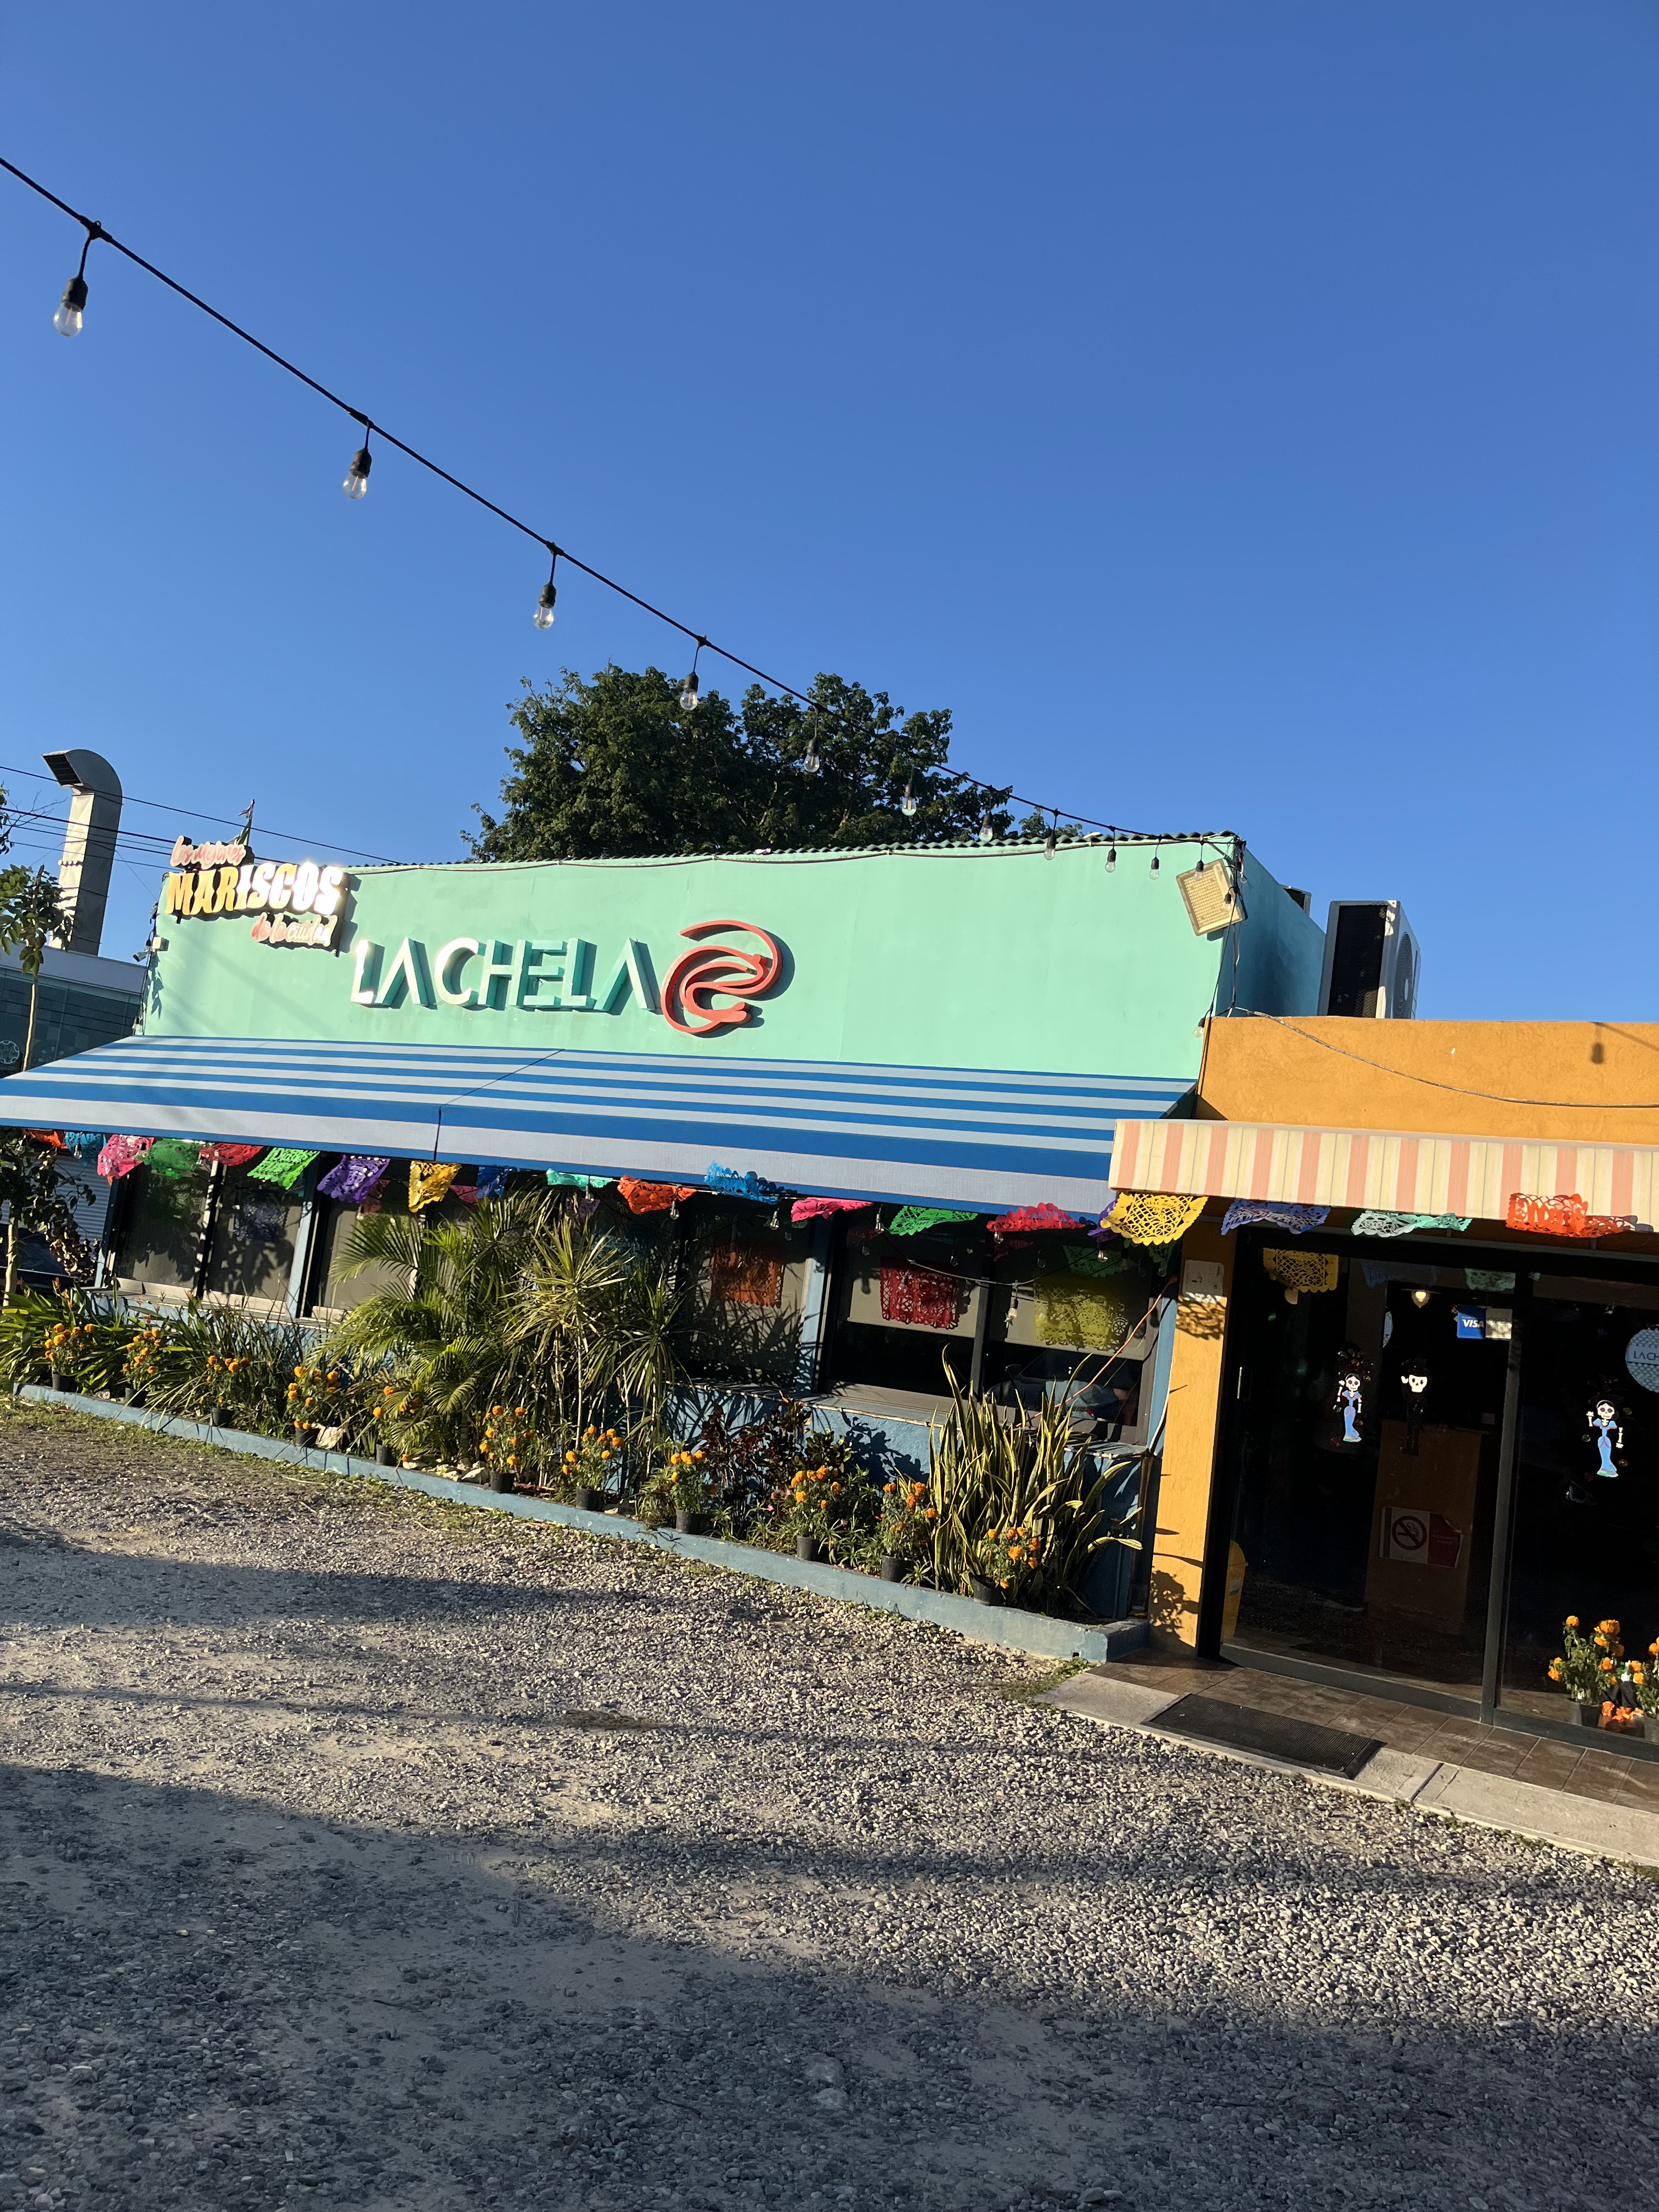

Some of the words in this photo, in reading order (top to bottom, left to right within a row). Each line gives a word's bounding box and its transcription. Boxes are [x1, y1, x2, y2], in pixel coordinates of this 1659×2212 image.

[165, 862, 343, 915] MARISCOS
[250, 912, 270, 941] de
[269, 913, 286, 943] la
[286, 915, 337, 946] ciudad
[1462, 1319, 1485, 1328] VISA
